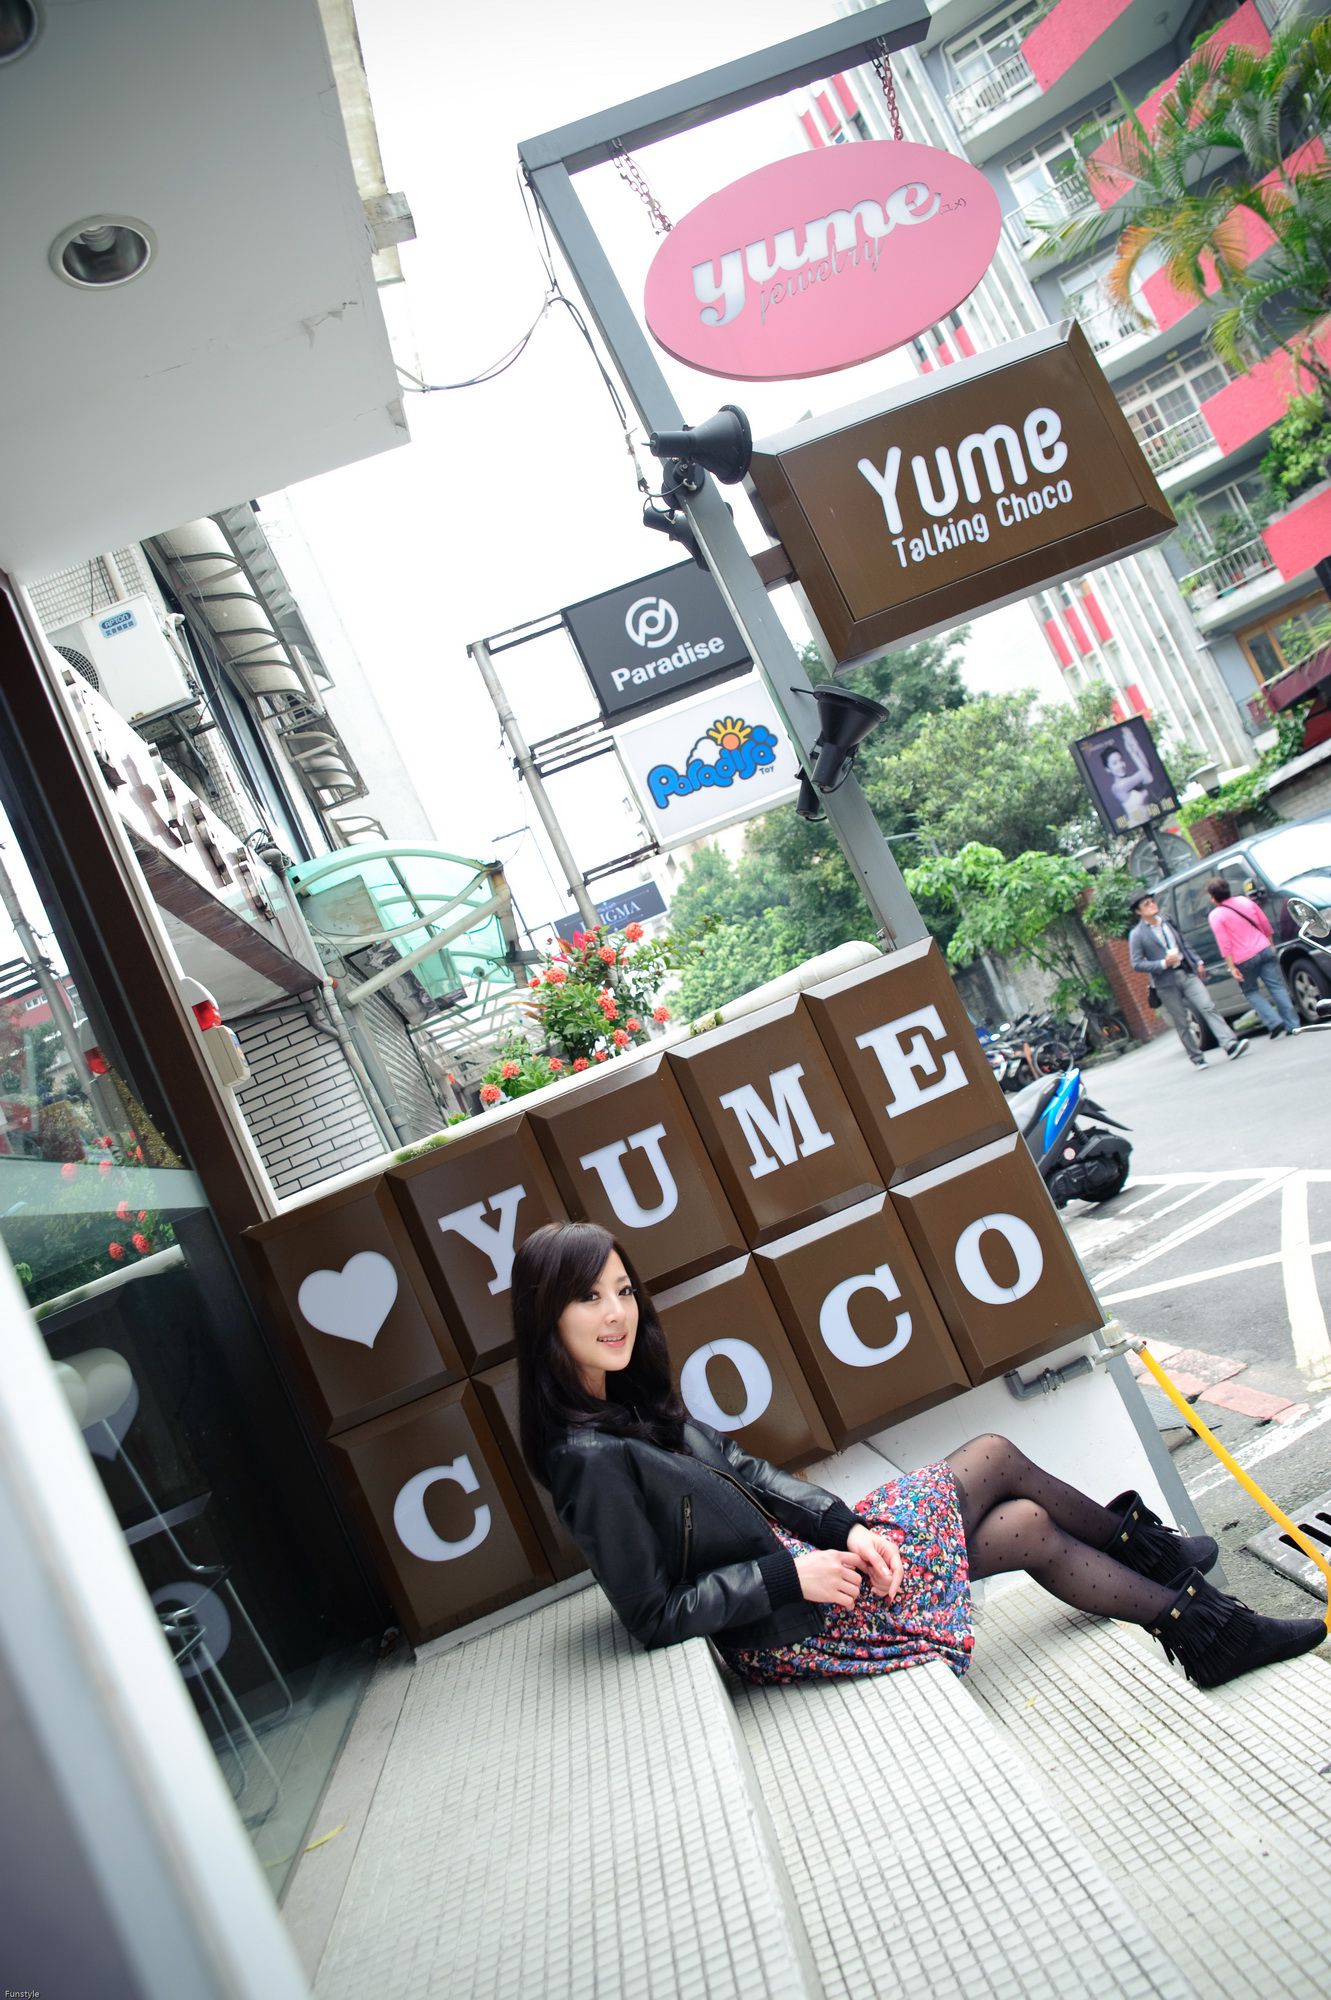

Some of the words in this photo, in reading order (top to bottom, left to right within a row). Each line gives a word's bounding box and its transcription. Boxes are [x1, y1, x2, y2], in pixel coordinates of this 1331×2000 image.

[692, 181, 941, 327] yume
[760, 236, 886, 327] jewelry
[857, 407, 1068, 535] Yume
[892, 513, 990, 568] Talking
[996, 480, 1073, 527] Choco
[611, 637, 725, 692] Paradise
[437, 1003, 970, 1296] YUME
[393, 1212, 1045, 1562] COCO
